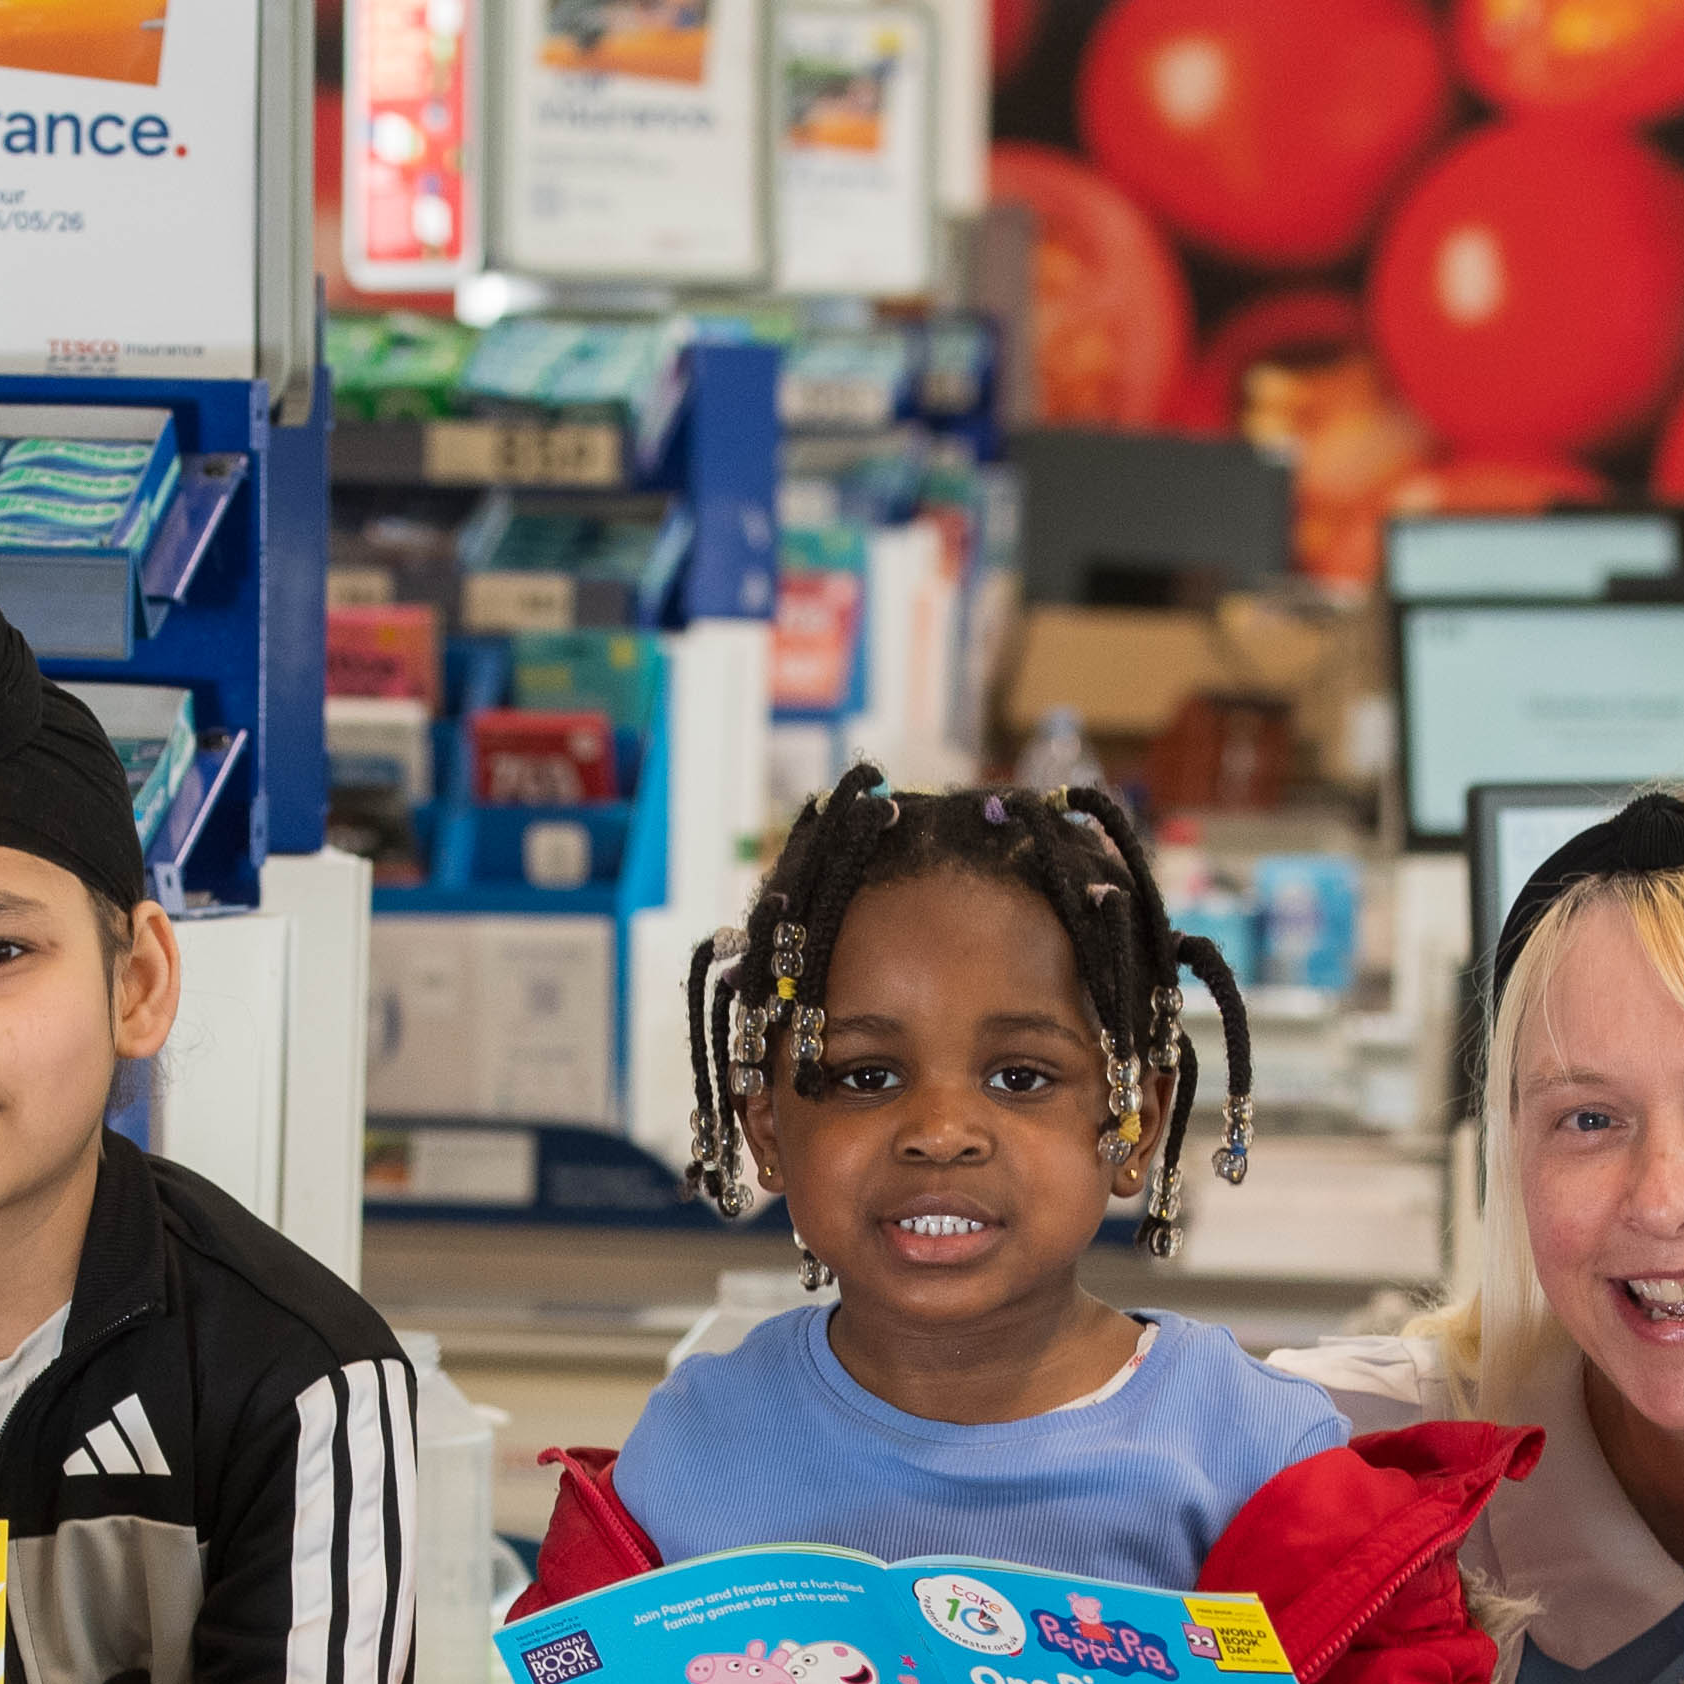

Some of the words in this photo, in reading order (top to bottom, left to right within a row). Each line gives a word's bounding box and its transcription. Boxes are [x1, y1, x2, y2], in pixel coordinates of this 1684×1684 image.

[633, 1610, 661, 1627] Join
[661, 1600, 705, 1619] Peppa
[706, 1589, 732, 1604] and
[733, 1581, 779, 1598] friends
[780, 1579, 798, 1591] for
[811, 1579, 865, 1594] fun-filled
[663, 1613, 705, 1633] family
[707, 1601, 752, 1621] games
[752, 1595, 778, 1611] day
[796, 1591, 816, 1603] the
[952, 1583, 1004, 1616] take
[526, 1634, 587, 1663] NATIONAL
[1038, 1614, 1129, 1667] Peppa
[1116, 1627, 1168, 1671] Pig
[1216, 1626, 1267, 1639] WORLD
[1221, 1636, 1262, 1648] BOOK
[531, 1643, 594, 1677] BOOK
[1226, 1645, 1252, 1656] DAY
